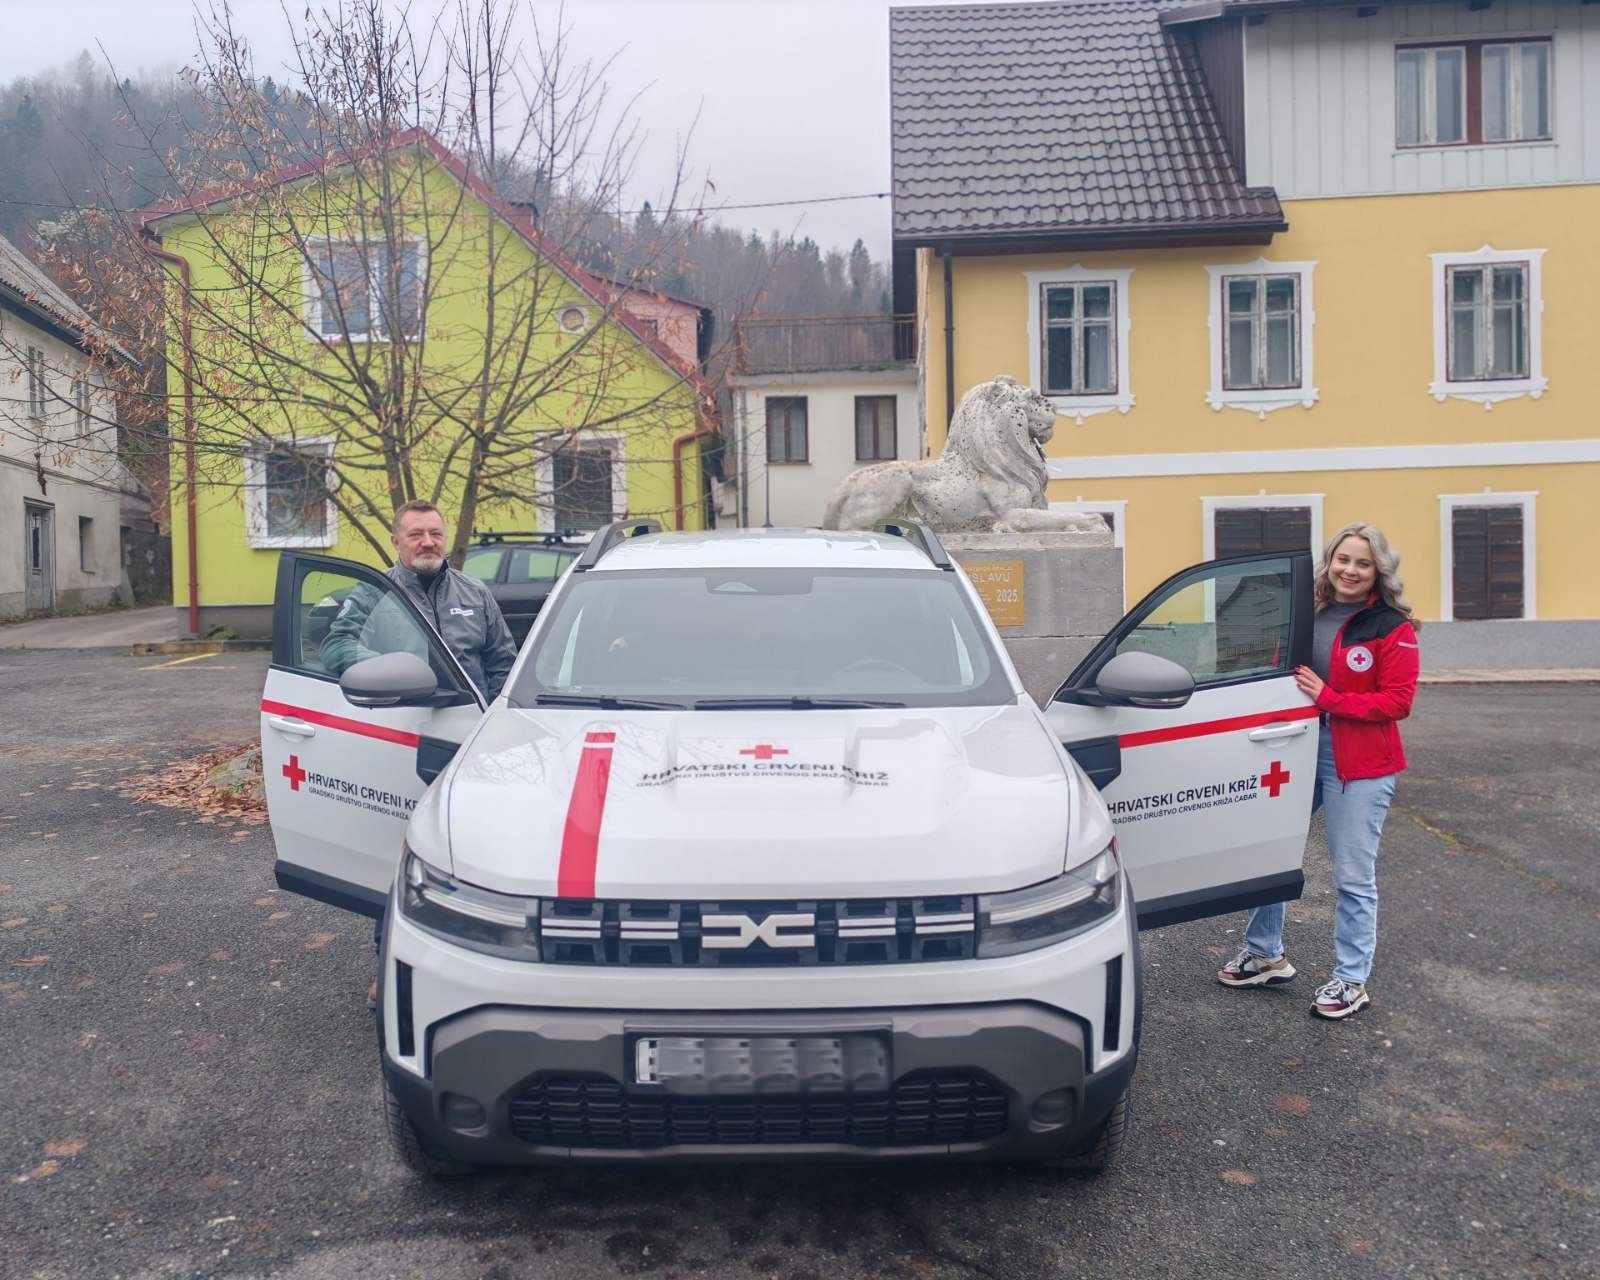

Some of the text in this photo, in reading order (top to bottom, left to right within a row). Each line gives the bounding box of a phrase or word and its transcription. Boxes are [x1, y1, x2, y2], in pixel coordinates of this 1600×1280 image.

[642, 764, 747, 780] HRVATSKI
[753, 763, 835, 771] CRVENI
[308, 771, 358, 796] HRVATSKI
[360, 786, 402, 809] CRVENI
[335, 794, 362, 809] DRUŠTVO
[362, 802, 391, 816] CRVENOG
[1107, 774, 1258, 815] HRVATSKI CRVENI KRIŽ
[1111, 814, 1143, 825] RADSKO
[1143, 807, 1178, 820] DRUŠTVO
[1178, 801, 1212, 814] CRVENOG
[1212, 795, 1234, 807] KRIŽA
